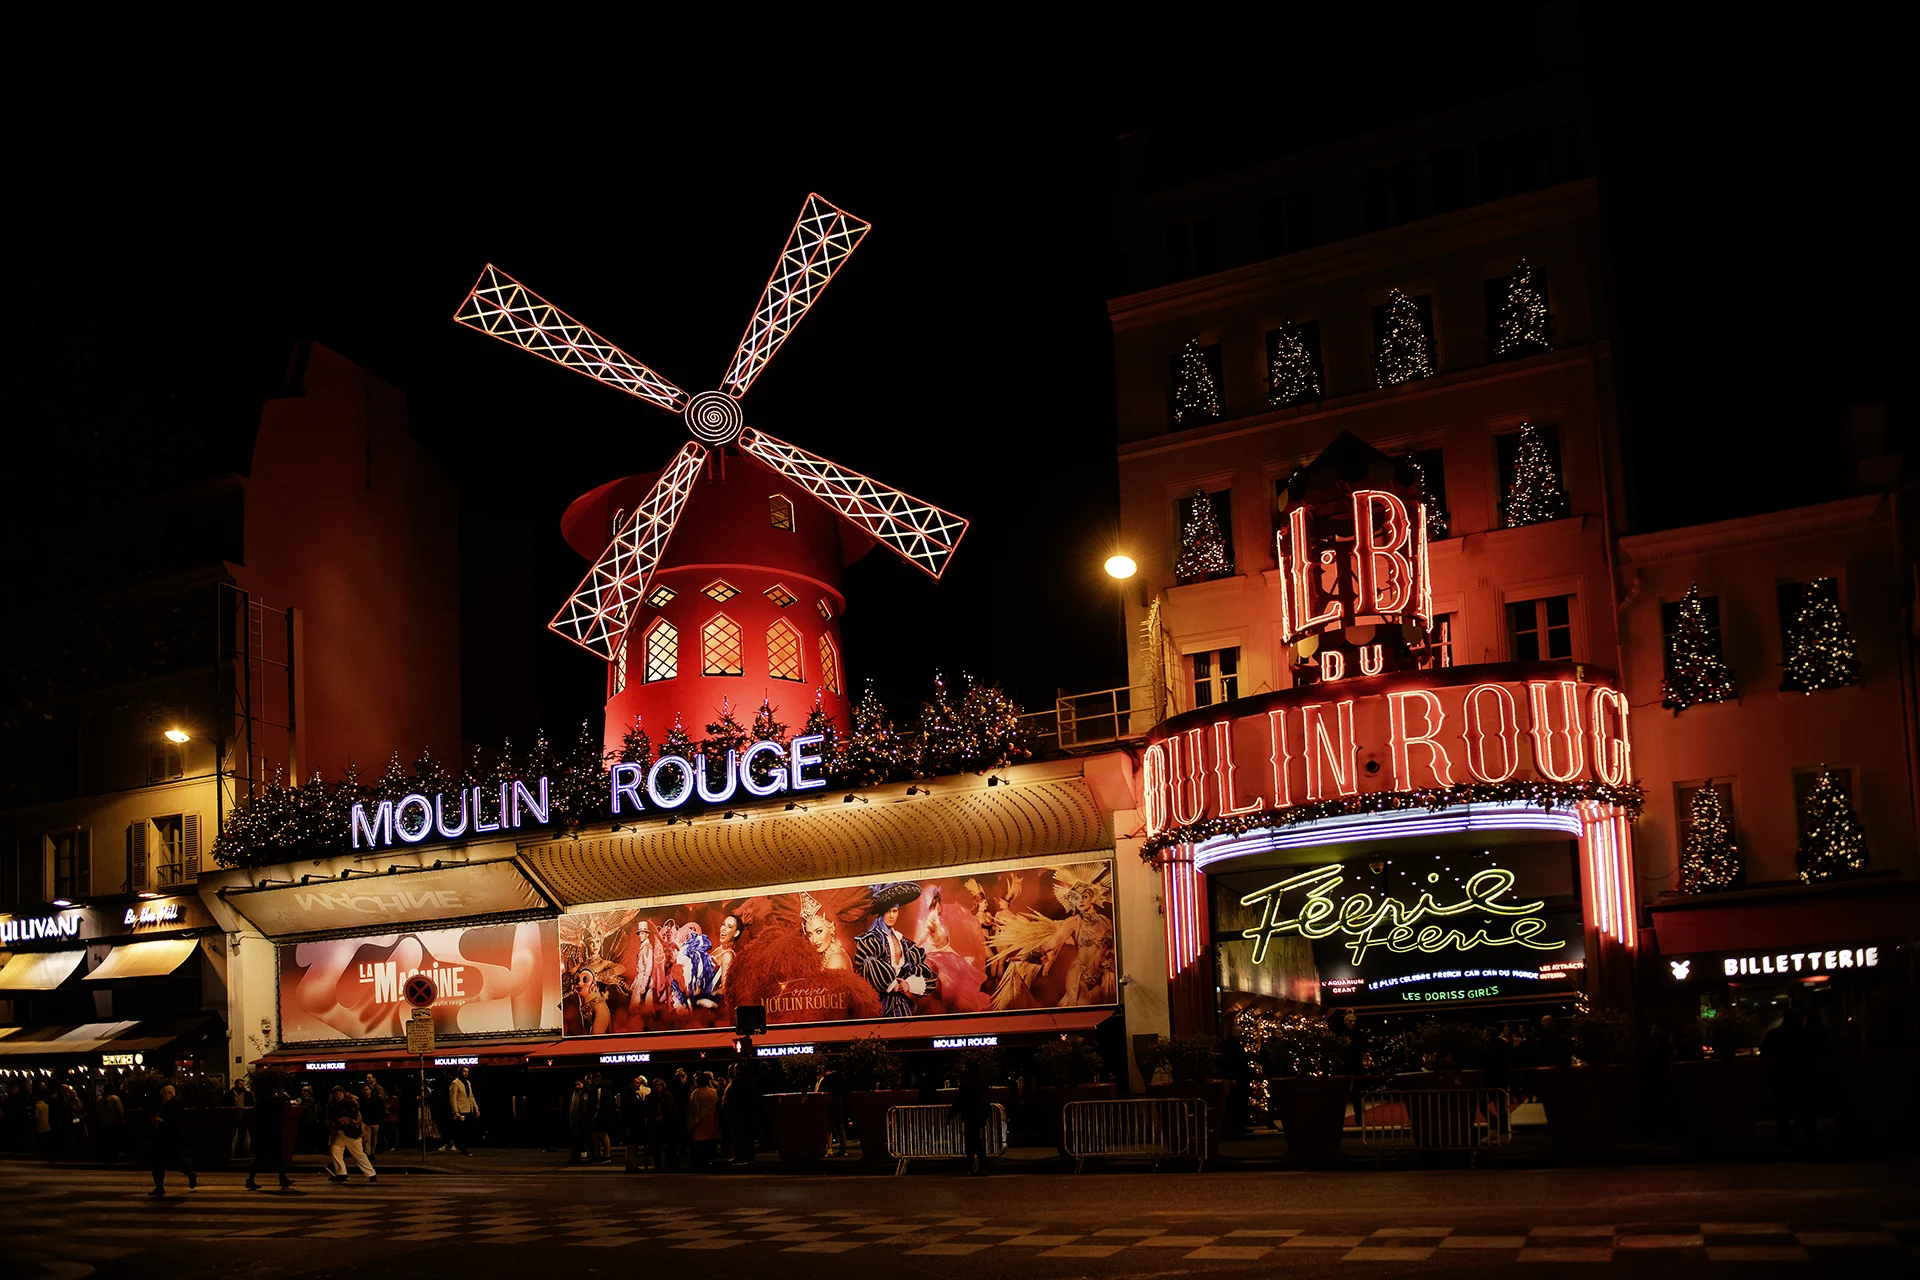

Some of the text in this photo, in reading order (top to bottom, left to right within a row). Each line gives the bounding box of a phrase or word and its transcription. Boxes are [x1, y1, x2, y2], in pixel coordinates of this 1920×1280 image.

[1321, 644, 1384, 682] DU
[1143, 683, 1632, 838] OULIN ROUG
[351, 734, 827, 849] MOULIN ROUGE
[1724, 946, 1879, 976] BILLETTERIE
[359, 963, 374, 979] LA
[1368, 983, 1379, 991] LE
[1379, 978, 1399, 989] PLUS
[1498, 969, 1510, 977] DU
[774, 977, 829, 998] Forever
[1402, 992, 1421, 1002] LES
[1425, 989, 1465, 1002] DORISS
[760, 992, 847, 1014] MOULIN ROUGE
[933, 1036, 998, 1048] MOULIN ROUGE
[599, 1054, 650, 1064] MOULIN ROUGE
[757, 1046, 814, 1057] MOULIN ROUGE
[306, 1062, 346, 1070] MOULIN ROUGE
[434, 1057, 479, 1066] MOULIN ROUGE
